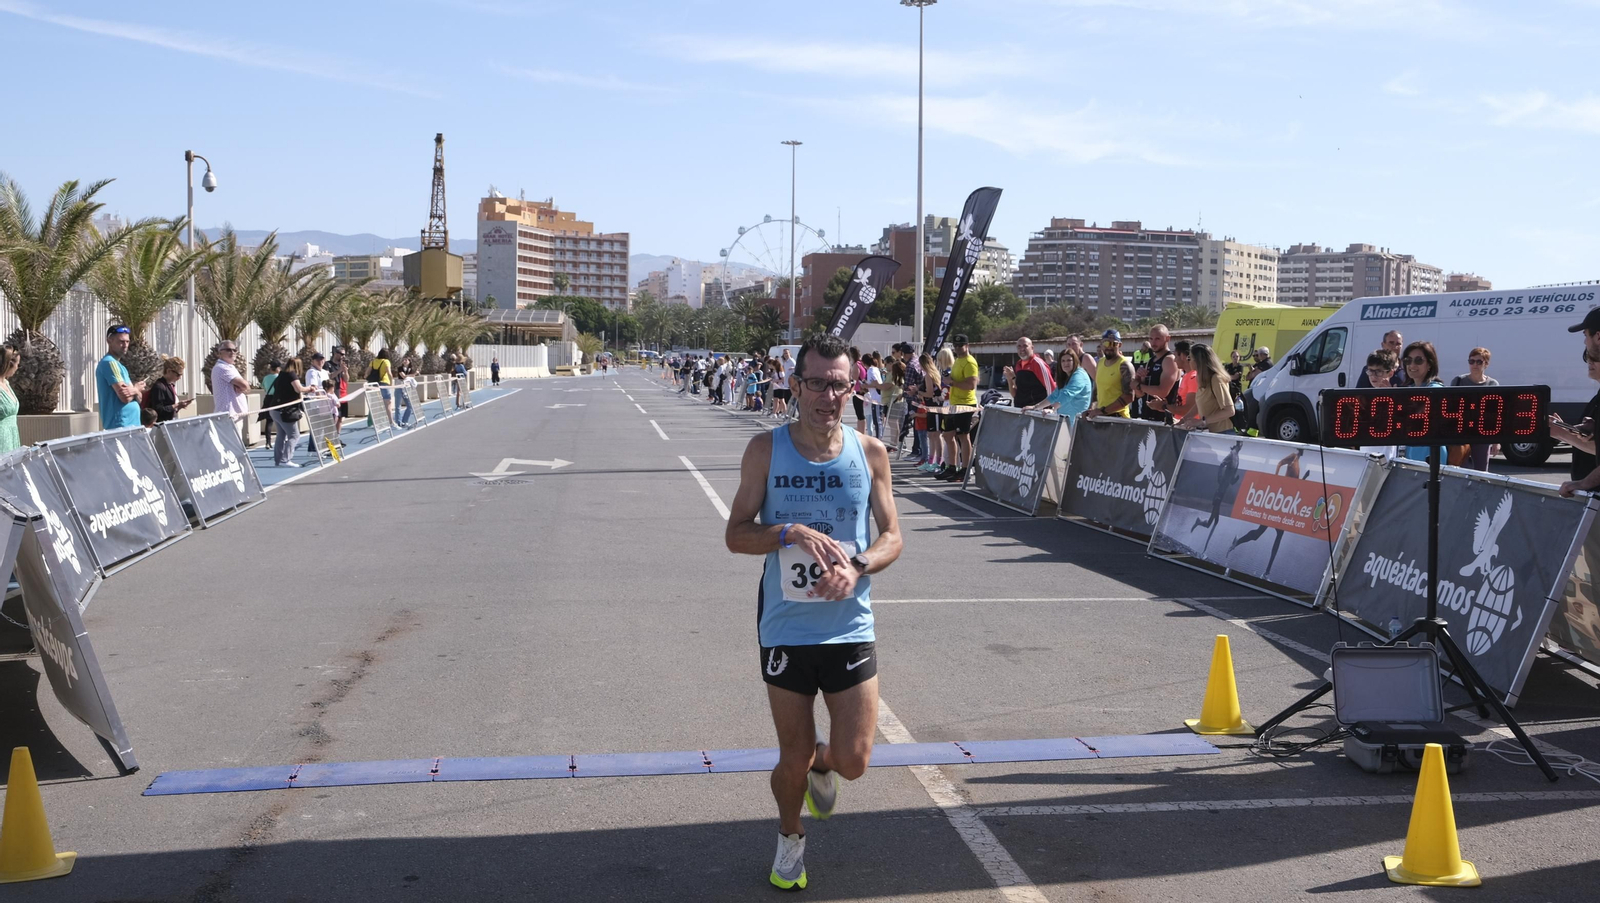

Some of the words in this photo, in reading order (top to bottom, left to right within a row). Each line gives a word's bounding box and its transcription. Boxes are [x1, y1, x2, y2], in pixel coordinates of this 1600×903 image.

[1363, 304, 1434, 319] Almericar
[1449, 297, 1503, 307] ALQUILER
[1507, 296, 1523, 304] DE
[1528, 292, 1595, 303] VEHÍCULOS
[1468, 308, 1499, 316] 950
[1503, 306, 1524, 315] 23
[1528, 305, 1549, 314] 49
[1554, 304, 1575, 313] 66
[832, 299, 857, 337] amos
[1235, 319, 1260, 327] SOPORTE
[1261, 319, 1275, 327] VITAL
[978, 452, 1022, 480] aquéatacamos
[774, 471, 843, 493] nerja
[1077, 472, 1146, 504] aquéatacamos
[783, 493, 834, 502] ATLETISMO
[1245, 482, 1313, 518] balabak.es
[90, 497, 152, 539] aquéatacamos
[791, 562, 838, 589] 39
